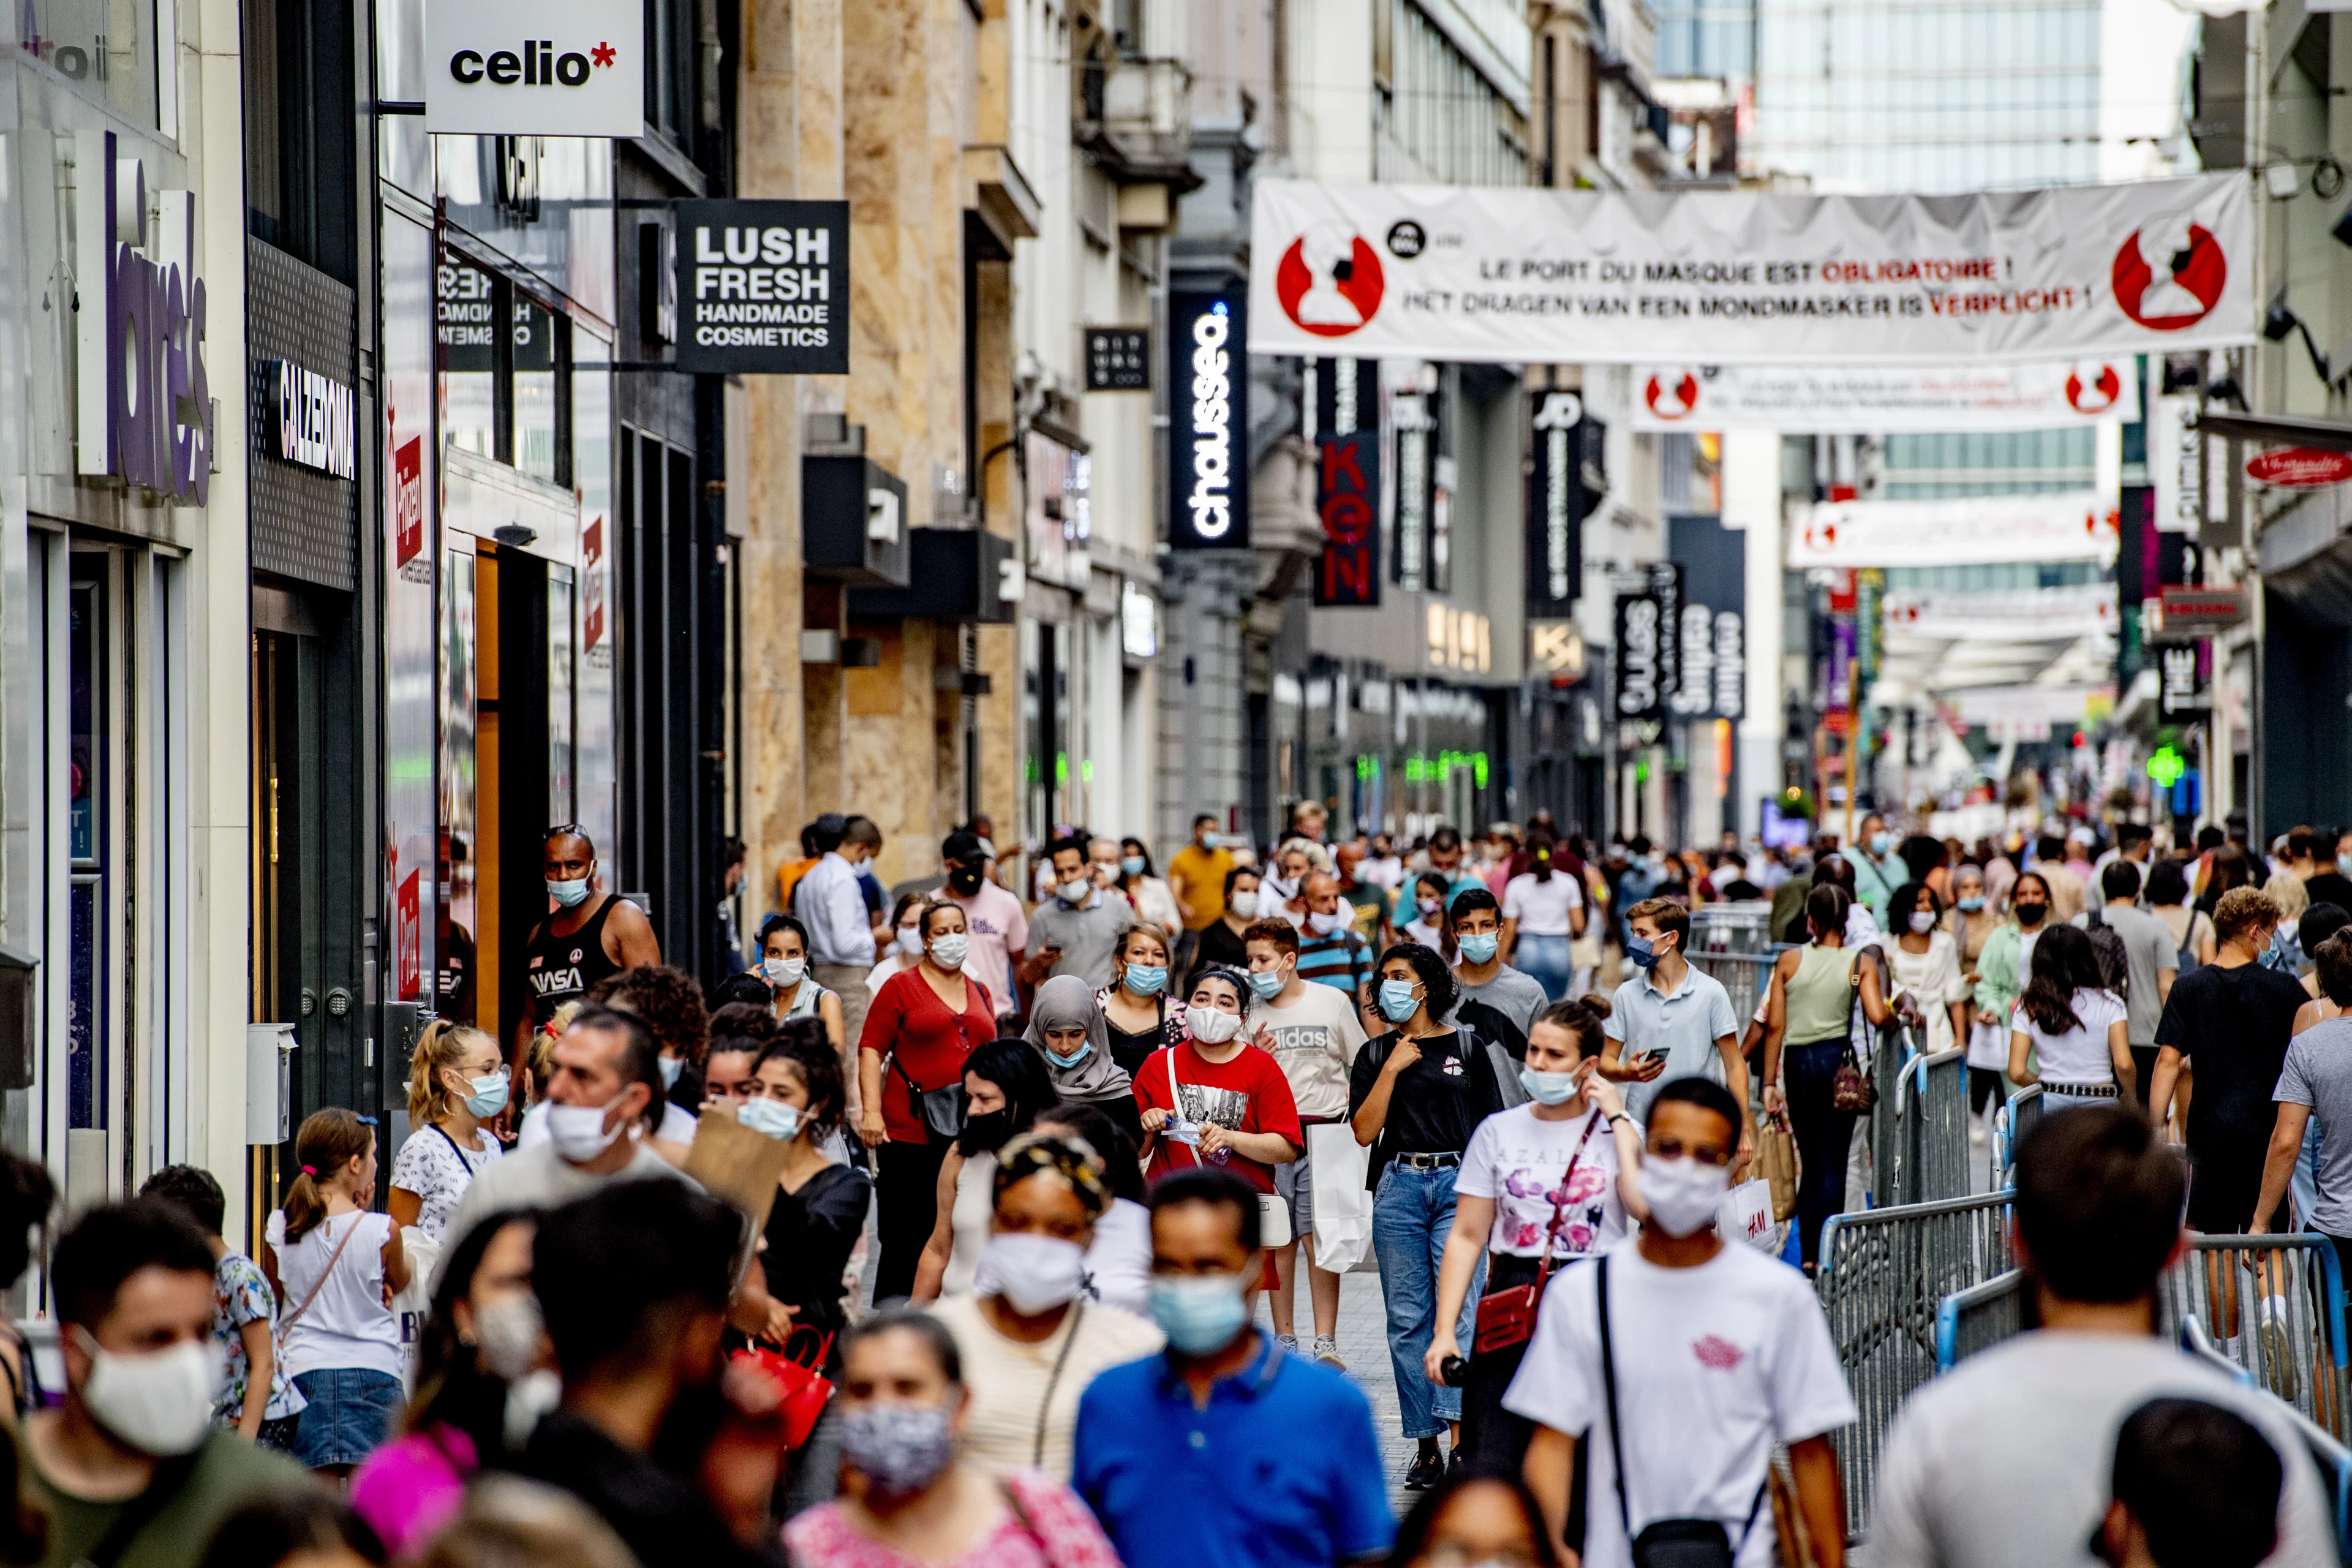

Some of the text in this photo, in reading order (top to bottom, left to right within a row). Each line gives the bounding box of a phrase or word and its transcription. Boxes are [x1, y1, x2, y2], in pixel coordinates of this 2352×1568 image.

[696, 227, 829, 265] LUSH
[696, 268, 829, 301] FRESH
[1480, 258, 1511, 281] LE
[1521, 260, 1588, 281] PORT
[1600, 260, 1635, 282] DU
[1645, 261, 1755, 284] MASQUE
[1766, 261, 1812, 284] EST
[1822, 257, 1997, 283] OBLIGATOIRE
[696, 305, 828, 324] HANDMADE
[1403, 290, 1452, 313] HET
[1462, 292, 1571, 315] DRAGEN
[1578, 294, 1629, 316] VAN
[1638, 295, 1689, 318] EEN
[1701, 294, 1890, 318] MONDMASKER
[1899, 293, 1924, 317] IS
[1929, 287, 2074, 317] VERPLICHT
[696, 327, 828, 347] COSMETICS
[280, 359, 355, 481] CALZEDONIA
[397, 466, 421, 545] Prijzen
[530, 967, 583, 993] NASA
[1275, 1027, 1326, 1049] idas
